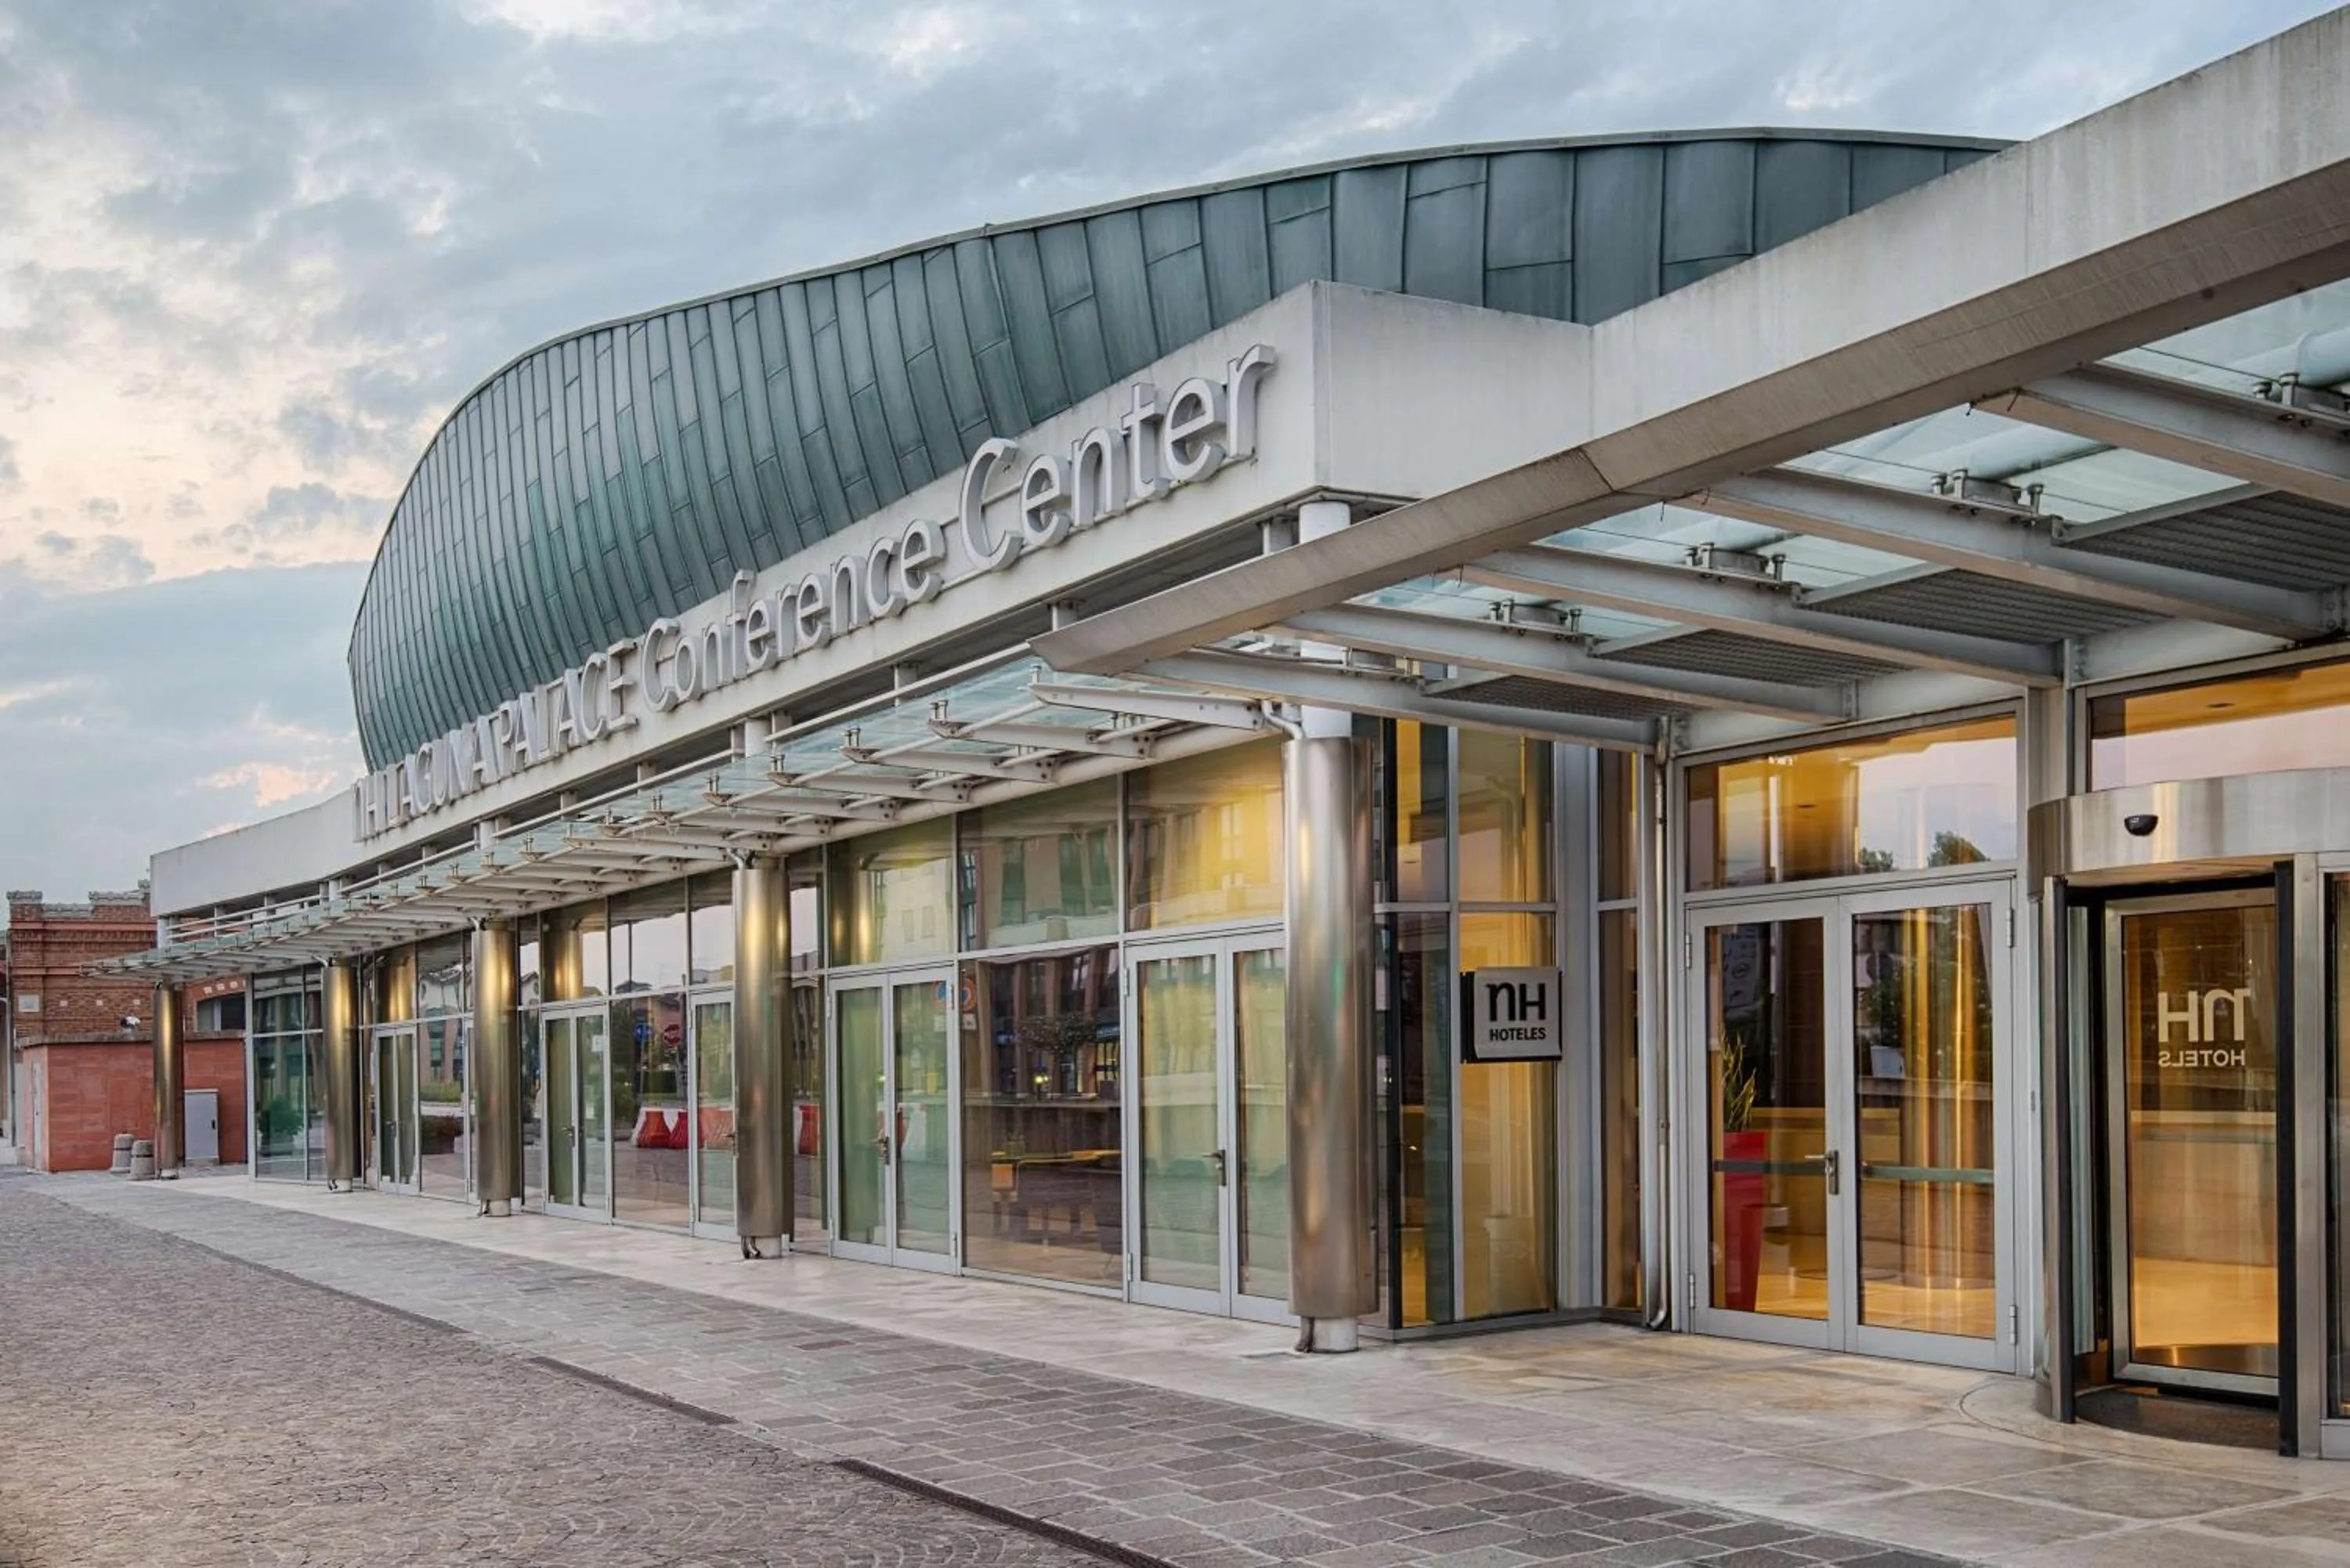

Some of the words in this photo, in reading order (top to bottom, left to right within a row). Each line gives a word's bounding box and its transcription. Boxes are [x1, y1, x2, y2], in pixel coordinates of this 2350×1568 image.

[498, 638, 639, 778] PALACE
[642, 518, 945, 713] Conference
[960, 344, 1276, 572] Center
[1489, 1027, 1546, 1041] HOTELES
